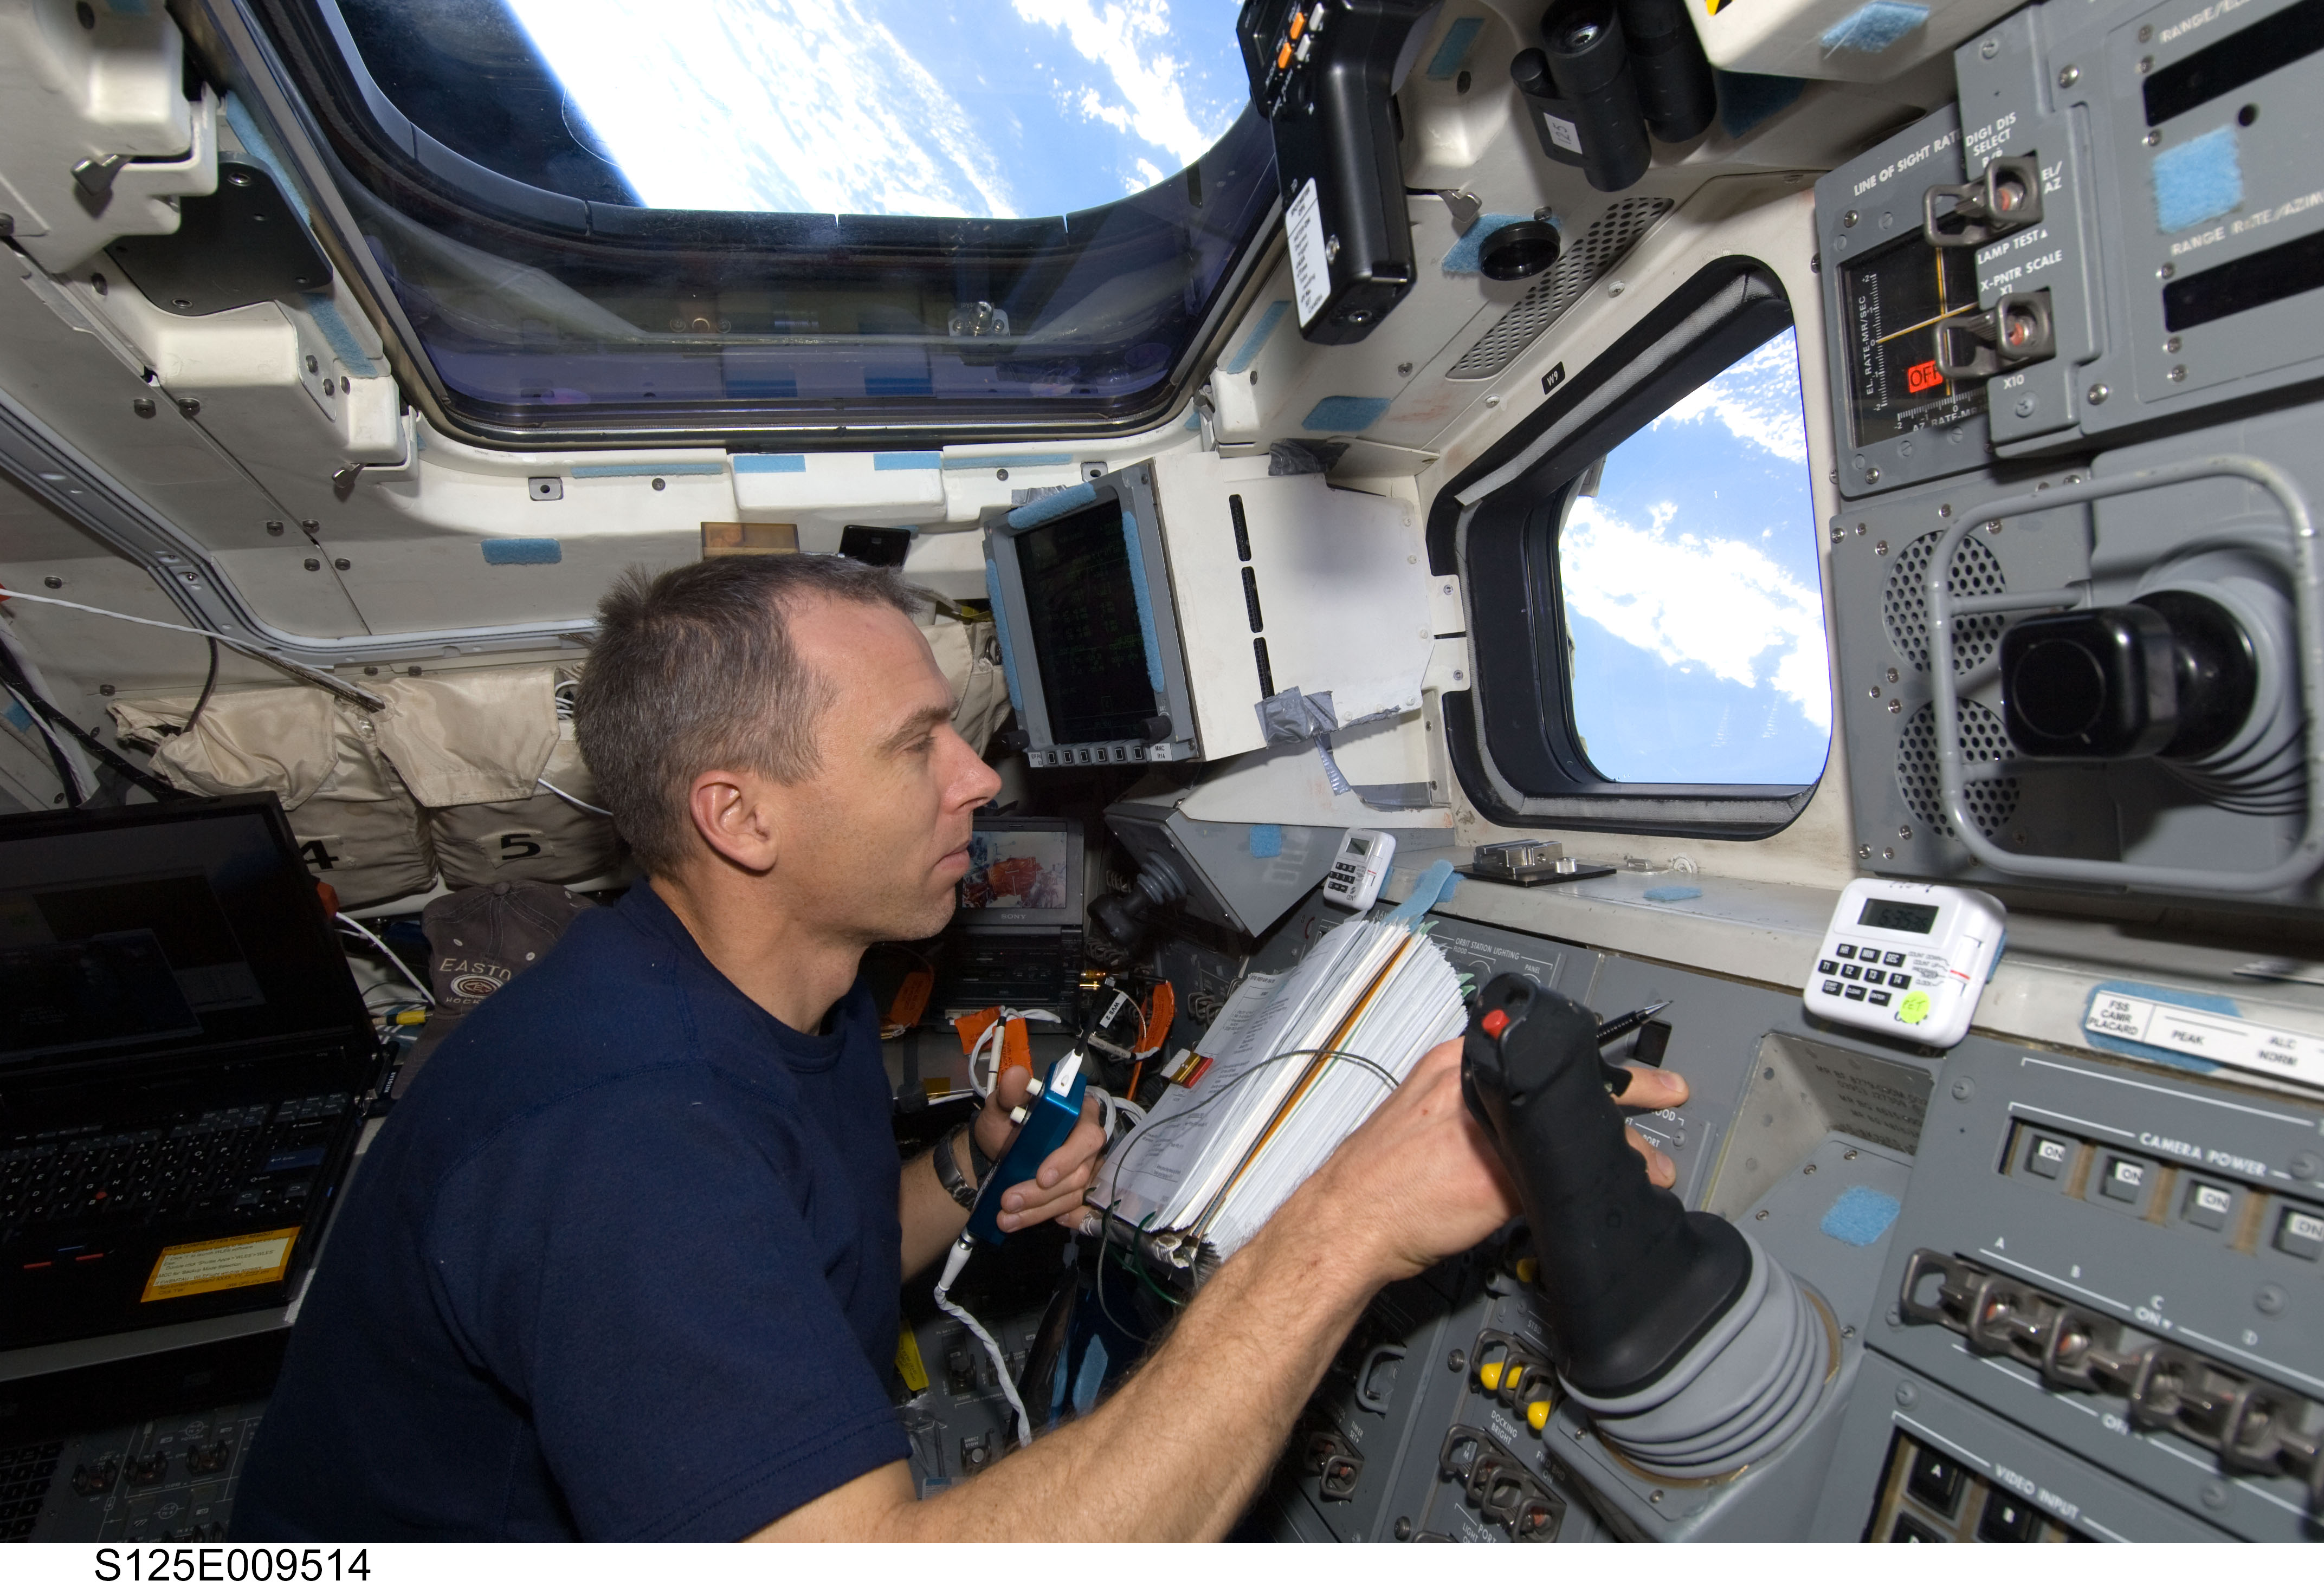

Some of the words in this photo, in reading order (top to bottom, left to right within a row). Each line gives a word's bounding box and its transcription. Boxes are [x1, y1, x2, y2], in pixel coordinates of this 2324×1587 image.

[1966, 122, 1992, 147] DIGI
[1997, 112, 2017, 132] DIS
[1973, 128, 2011, 157] SELECT
[1854, 174, 1877, 196] LINE
[1878, 165, 1895, 183] OF
[1897, 145, 1931, 173] SIGHT
[2042, 160, 2063, 181] EL/
[2043, 177, 2062, 195] AZ
[1977, 243, 2010, 265] LAMP
[2013, 229, 2039, 251] TEST
[2171, 226, 2226, 256] RANGE
[1980, 267, 2023, 293] X-PNTR
[2026, 250, 2063, 274] SCALE
[1547, 370, 1558, 386] W9
[2003, 374, 2025, 390] X10
[300, 839, 339, 870] 4
[501, 833, 541, 860] 5
[1453, 945, 1468, 955] FLOOD
[1455, 937, 1470, 947] ORBIT
[1470, 941, 1492, 954] STATION
[1493, 948, 1520, 960] LIGHTING
[1885, 953, 1900, 963] SEC
[1525, 964, 1541, 974] PANEL
[1845, 966, 1854, 975] T2
[1893, 975, 1902, 984] T4
[1902, 998, 1926, 1012] PET
[2109, 1000, 2130, 1012] FSS
[2088, 1016, 2138, 1036] PLACARD
[2172, 1030, 2205, 1045] PEAK
[2268, 1035, 2297, 1050] ALC
[2257, 1050, 2299, 1066] NORM
[384, 1072, 397, 1093] NETGEAR
[2044, 1145, 2064, 1161] ON
[2139, 1132, 2203, 1161] CAMERA
[2206, 1149, 2267, 1177] POWER
[2121, 1167, 2143, 1184] ON
[2203, 1192, 2230, 1210] ON
[2297, 1219, 2324, 1238] ON
[1994, 1236, 2005, 1249] A
[2070, 1264, 2081, 1278] B
[2150, 1294, 2165, 1310] C
[2134, 1305, 2162, 1326] ON
[1527, 1319, 1542, 1335] STBD
[1351, 1420, 1364, 1439] TIMER
[1490, 1409, 1518, 1439] DOCKING
[1490, 1422, 1513, 1446] BRIGHT
[1535, 1450, 1552, 1469] FWD
[1551, 1463, 1566, 1482] BHD
[1931, 1463, 1942, 1479] A
[1542, 1470, 1554, 1485] ON
[1995, 1463, 2035, 1495] VIDEO
[2037, 1487, 2080, 1519] INPUT
[2002, 1506, 2016, 1524] B
[1462, 1523, 1479, 1543] LIGHT
[1477, 1524, 1497, 1543] PORT
